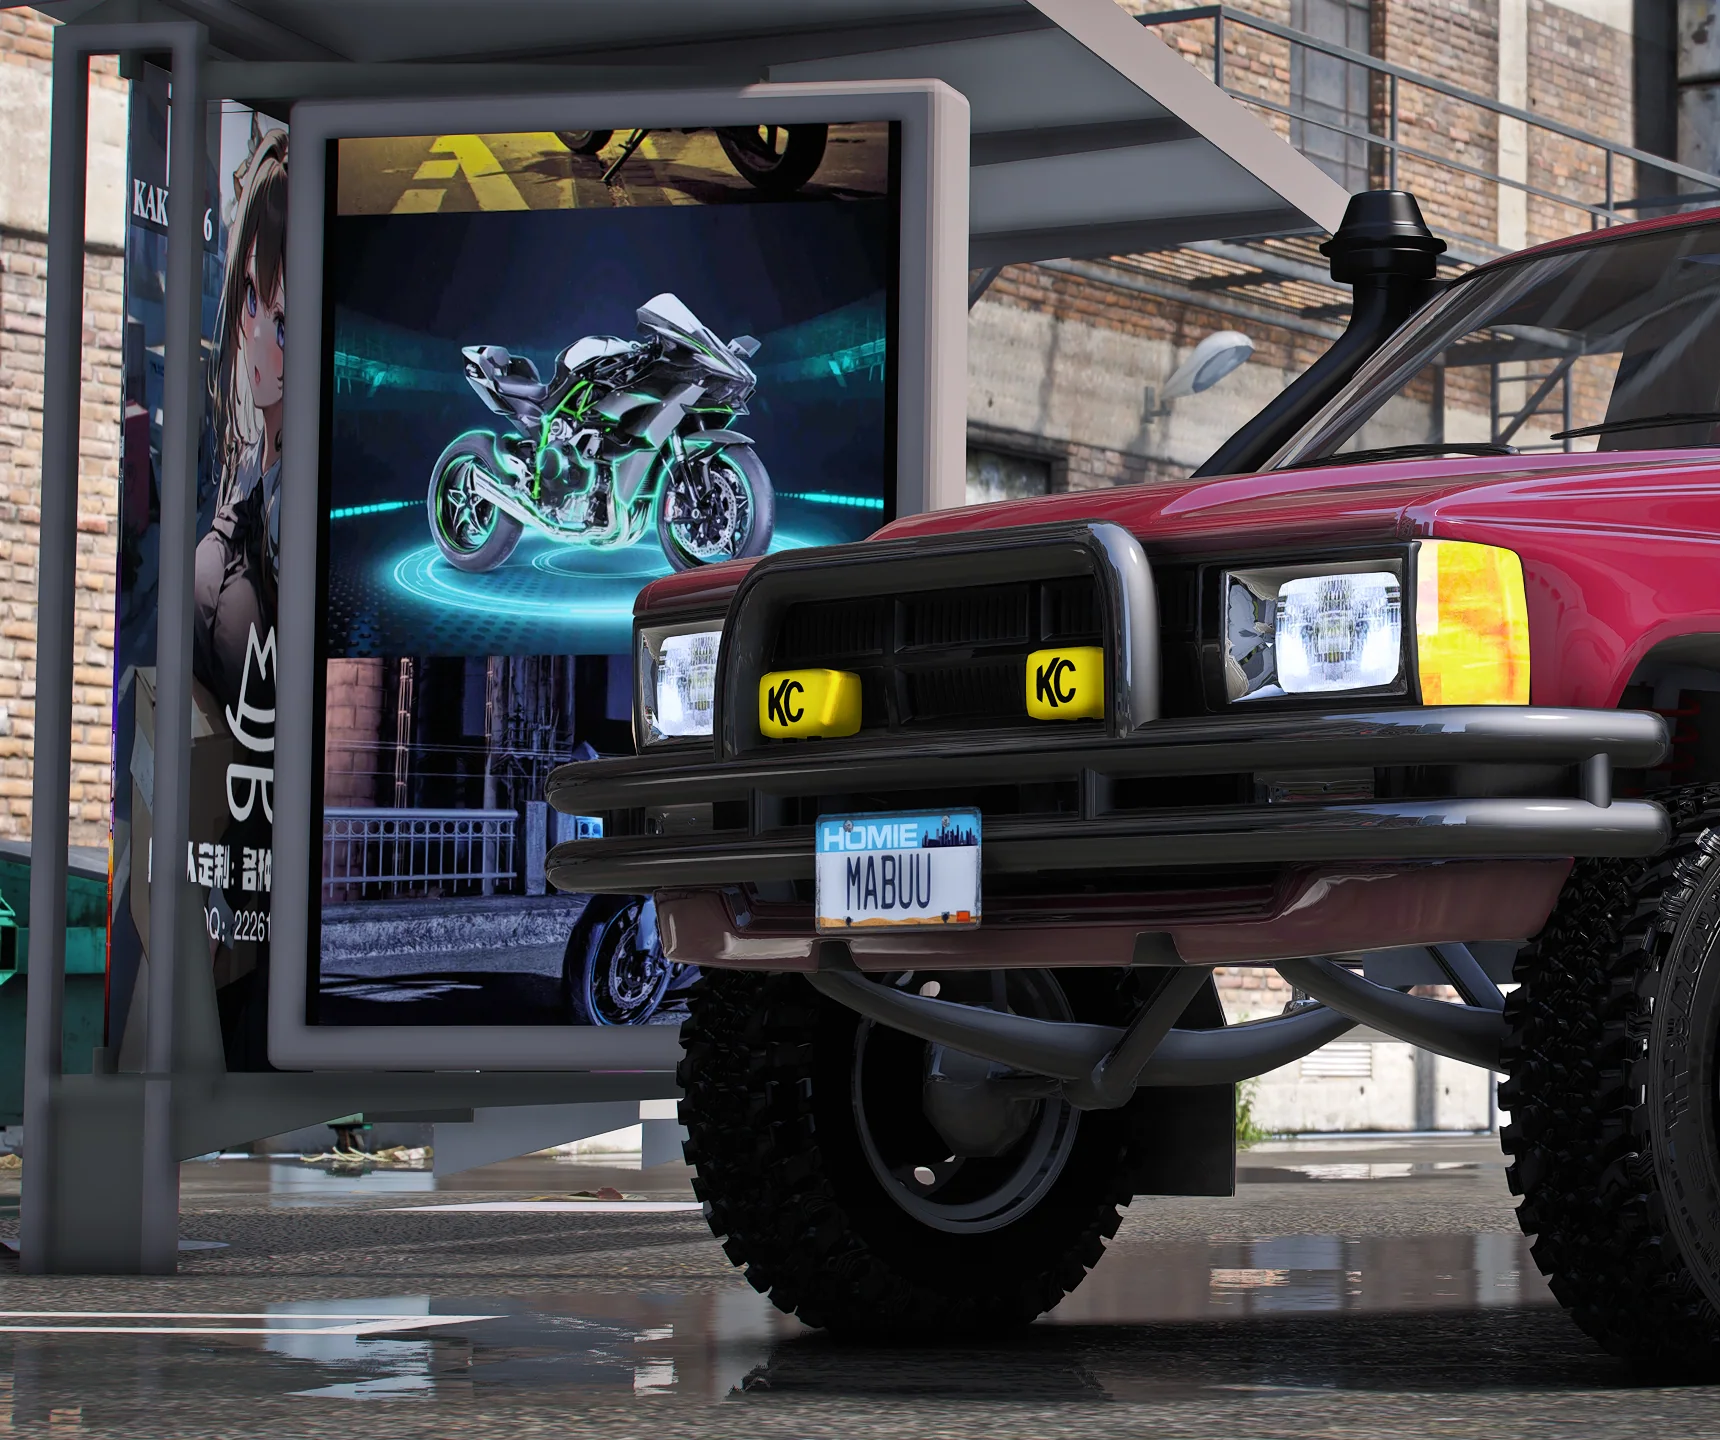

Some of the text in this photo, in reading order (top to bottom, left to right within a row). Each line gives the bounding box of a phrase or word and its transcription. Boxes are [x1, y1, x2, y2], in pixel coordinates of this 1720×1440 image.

[768, 678, 805, 727] KC
[1035, 656, 1077, 708] KC
[823, 822, 918, 851] HOMIE
[846, 852, 931, 911] MABUU
